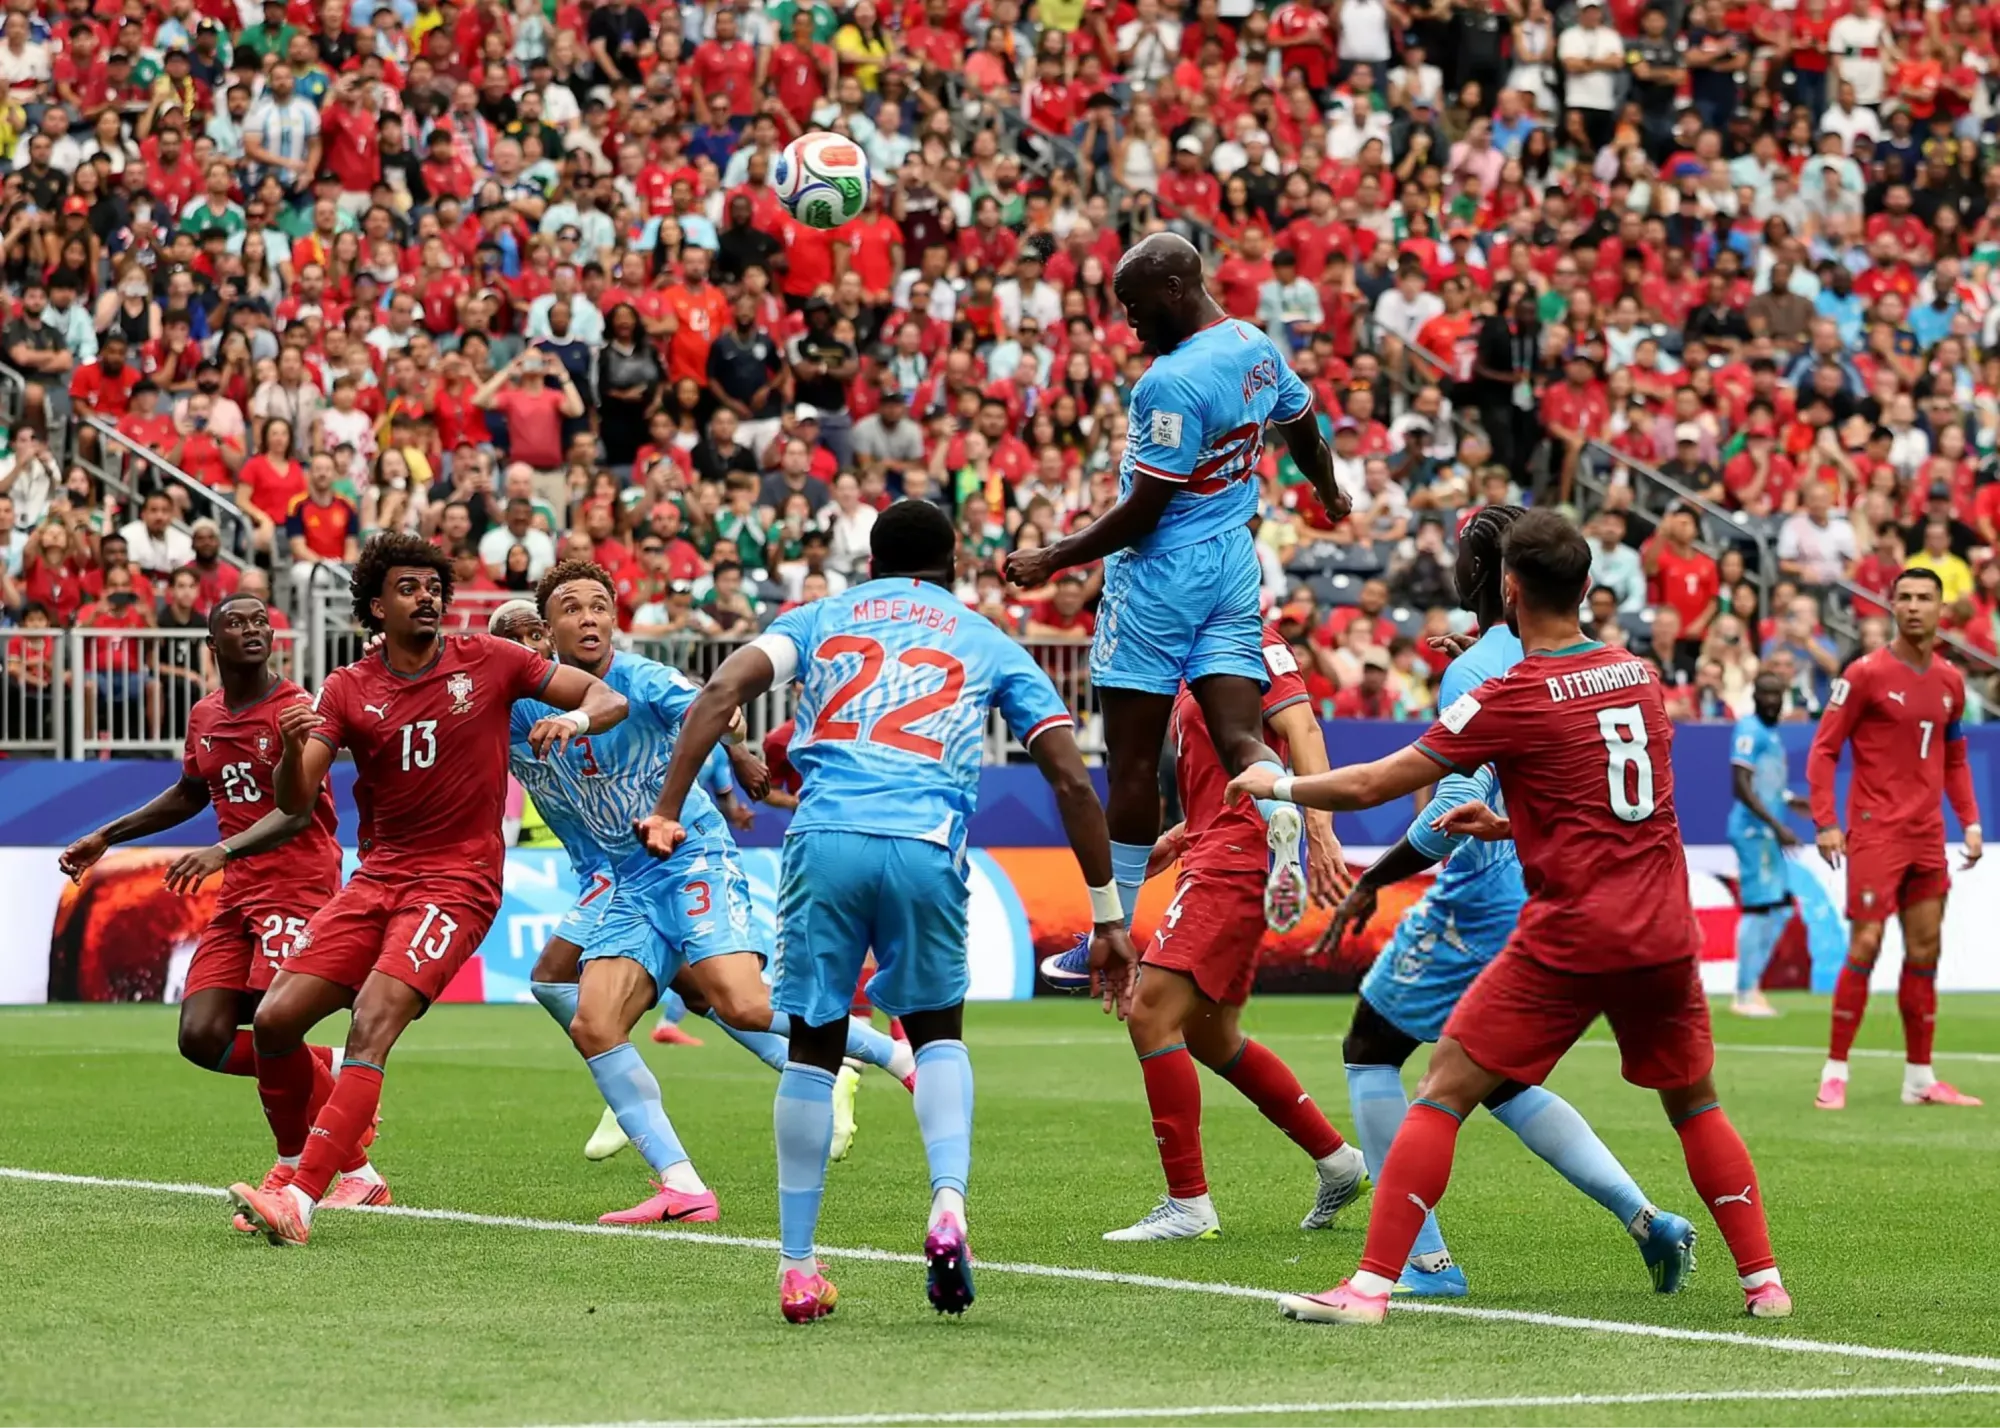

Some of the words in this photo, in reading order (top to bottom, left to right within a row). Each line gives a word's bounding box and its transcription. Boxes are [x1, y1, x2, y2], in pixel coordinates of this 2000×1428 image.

[853, 599, 957, 636] MBEMBA
[806, 634, 966, 762] 22
[400, 719, 438, 772] 13
[574, 736, 599, 777] 3
[1919, 720, 1934, 759] 7
[221, 762, 262, 803] 25
[1596, 703, 1655, 823] 8
[579, 873, 612, 907] 7
[683, 880, 712, 918] 3
[1164, 882, 1193, 929] 4
[261, 914, 306, 959] 25
[410, 903, 459, 960] 13
